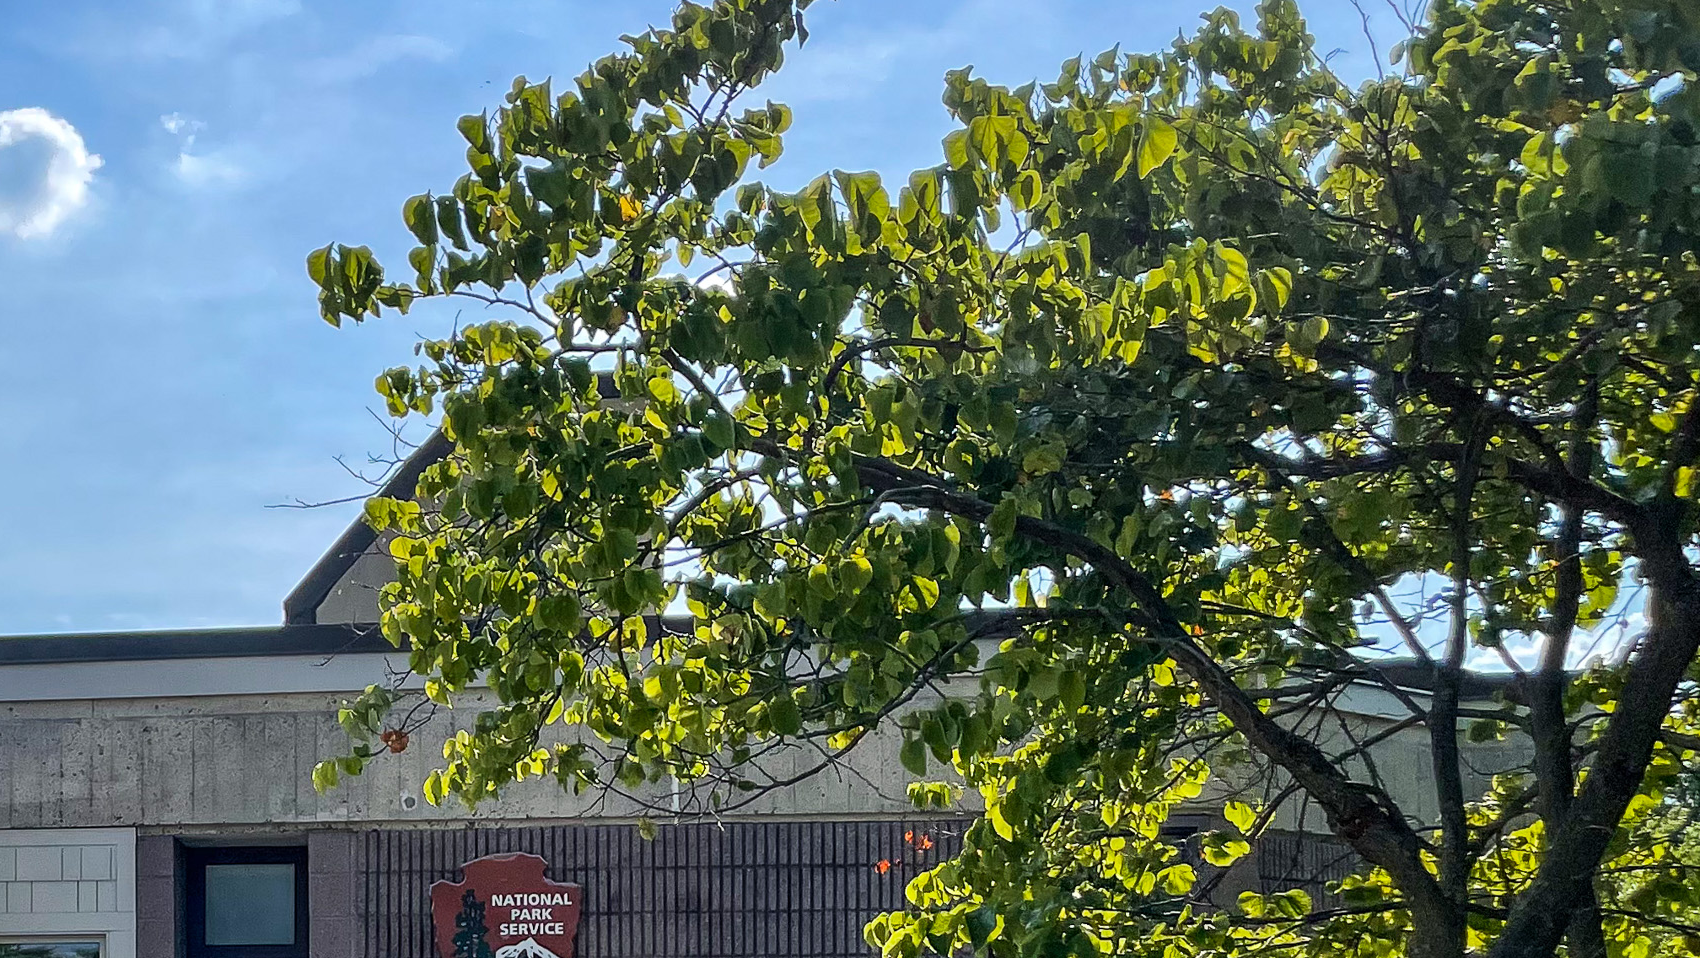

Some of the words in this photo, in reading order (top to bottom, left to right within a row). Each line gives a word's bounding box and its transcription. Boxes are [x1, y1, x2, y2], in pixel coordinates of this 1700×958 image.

[491, 893, 573, 906] NATIONAL
[510, 908, 552, 920] PARK
[499, 922, 564, 935] SERVICE
